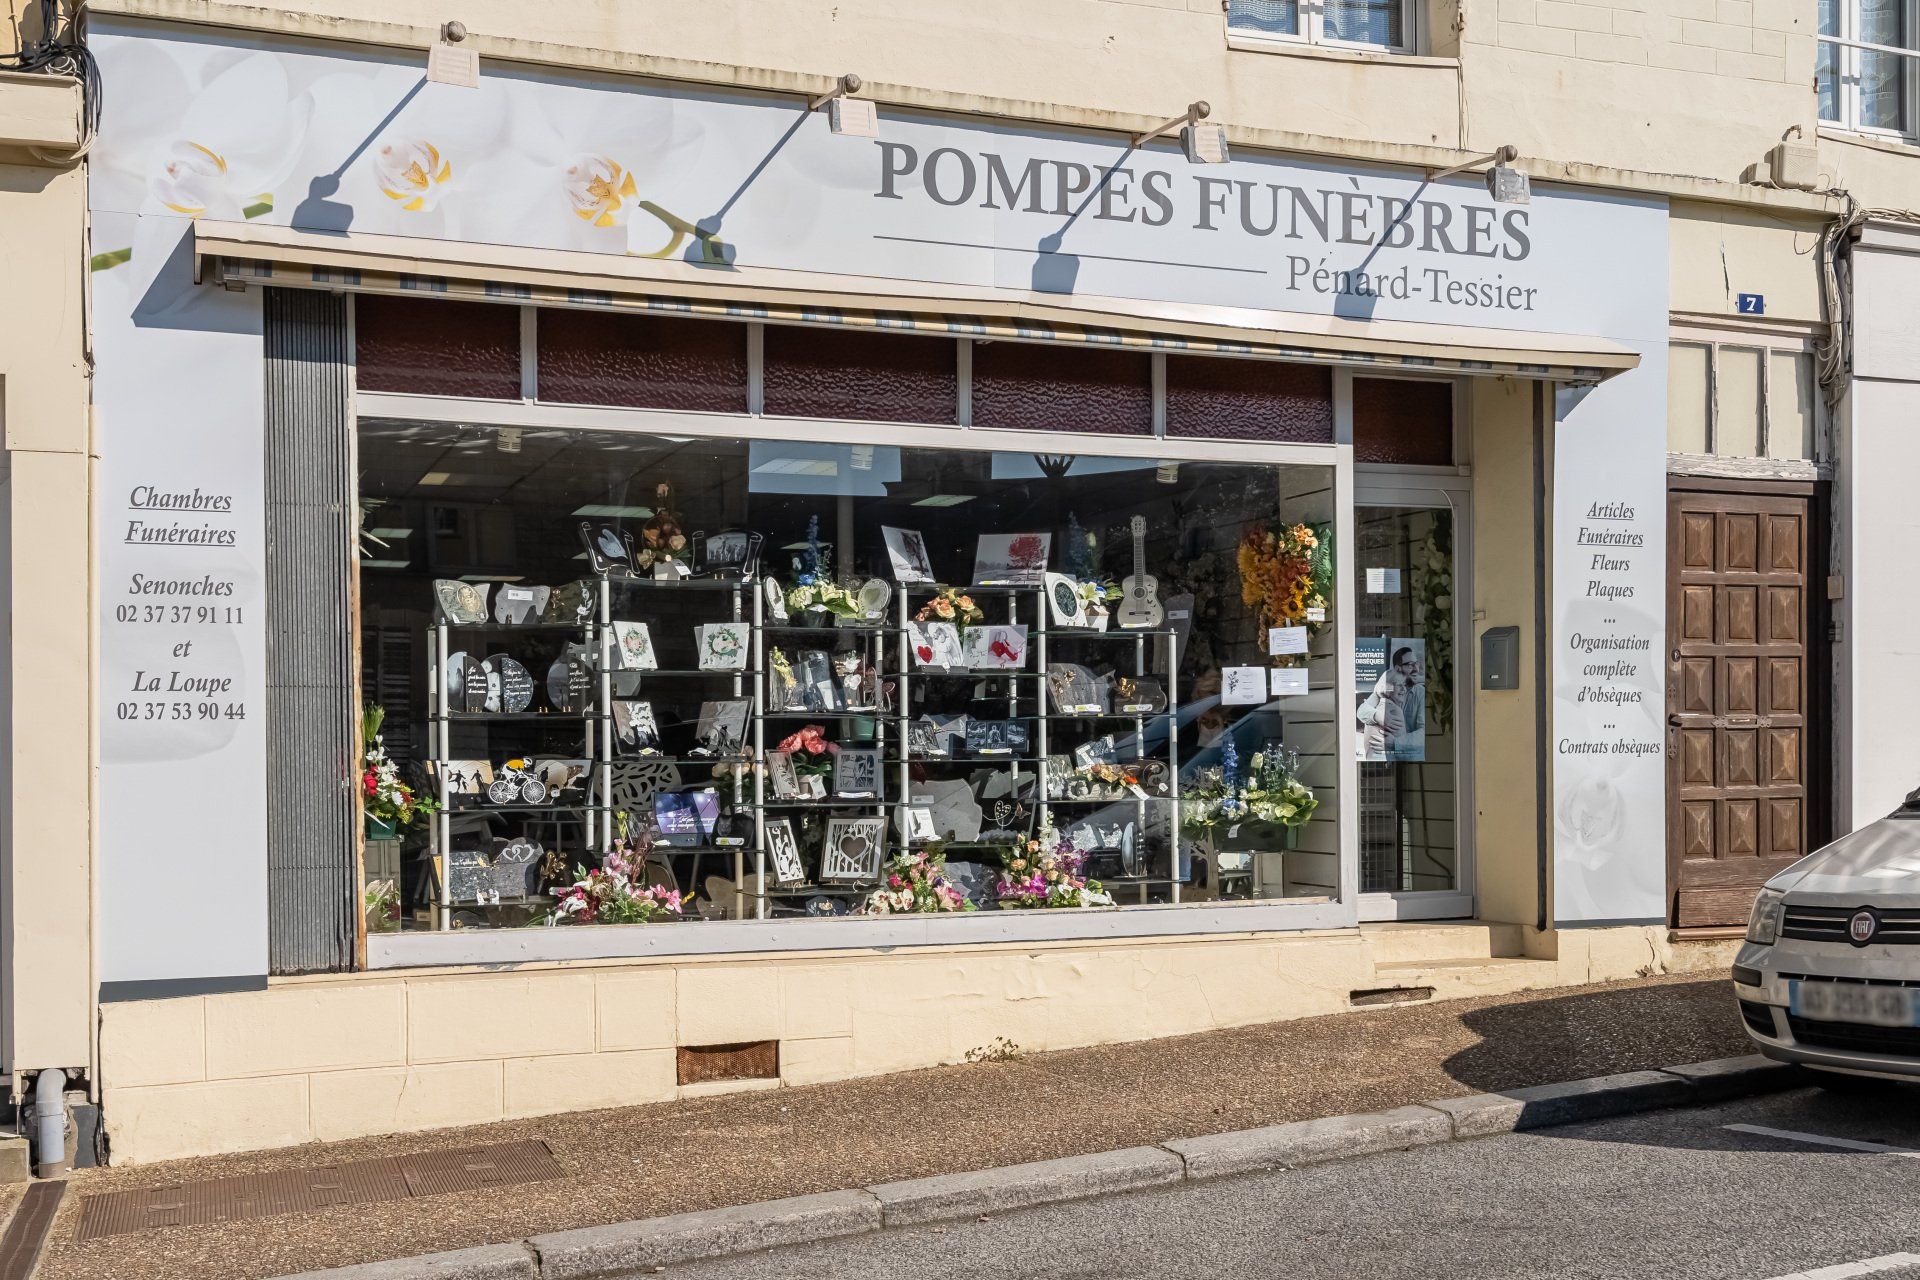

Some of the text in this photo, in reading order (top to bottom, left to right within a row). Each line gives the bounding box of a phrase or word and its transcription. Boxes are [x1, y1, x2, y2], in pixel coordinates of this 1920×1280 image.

[874, 141, 1531, 262] POMPES FUNÈBRES
[1286, 255, 1537, 311] Pénard-Tessier
[1746, 297, 1757, 311] 7
[130, 486, 232, 509] Chambres
[1586, 501, 1634, 518] Articles
[124, 521, 236, 543] Funéraires
[1577, 527, 1643, 544] Funéraires
[1590, 554, 1630, 571] Fleurs
[129, 573, 233, 596] Senonches
[1586, 580, 1634, 601] Plaques
[117, 605, 243, 624] 02 37 37 91 11
[173, 640, 192, 657] et
[1570, 633, 1649, 653] Organisation
[1584, 660, 1636, 680] complète
[131, 671, 231, 697] La Loupe
[117, 702, 246, 720] 02 37 53 90 44
[1559, 738, 1660, 757] Contrats obsèques
[1855, 920, 1870, 934] FIAT
